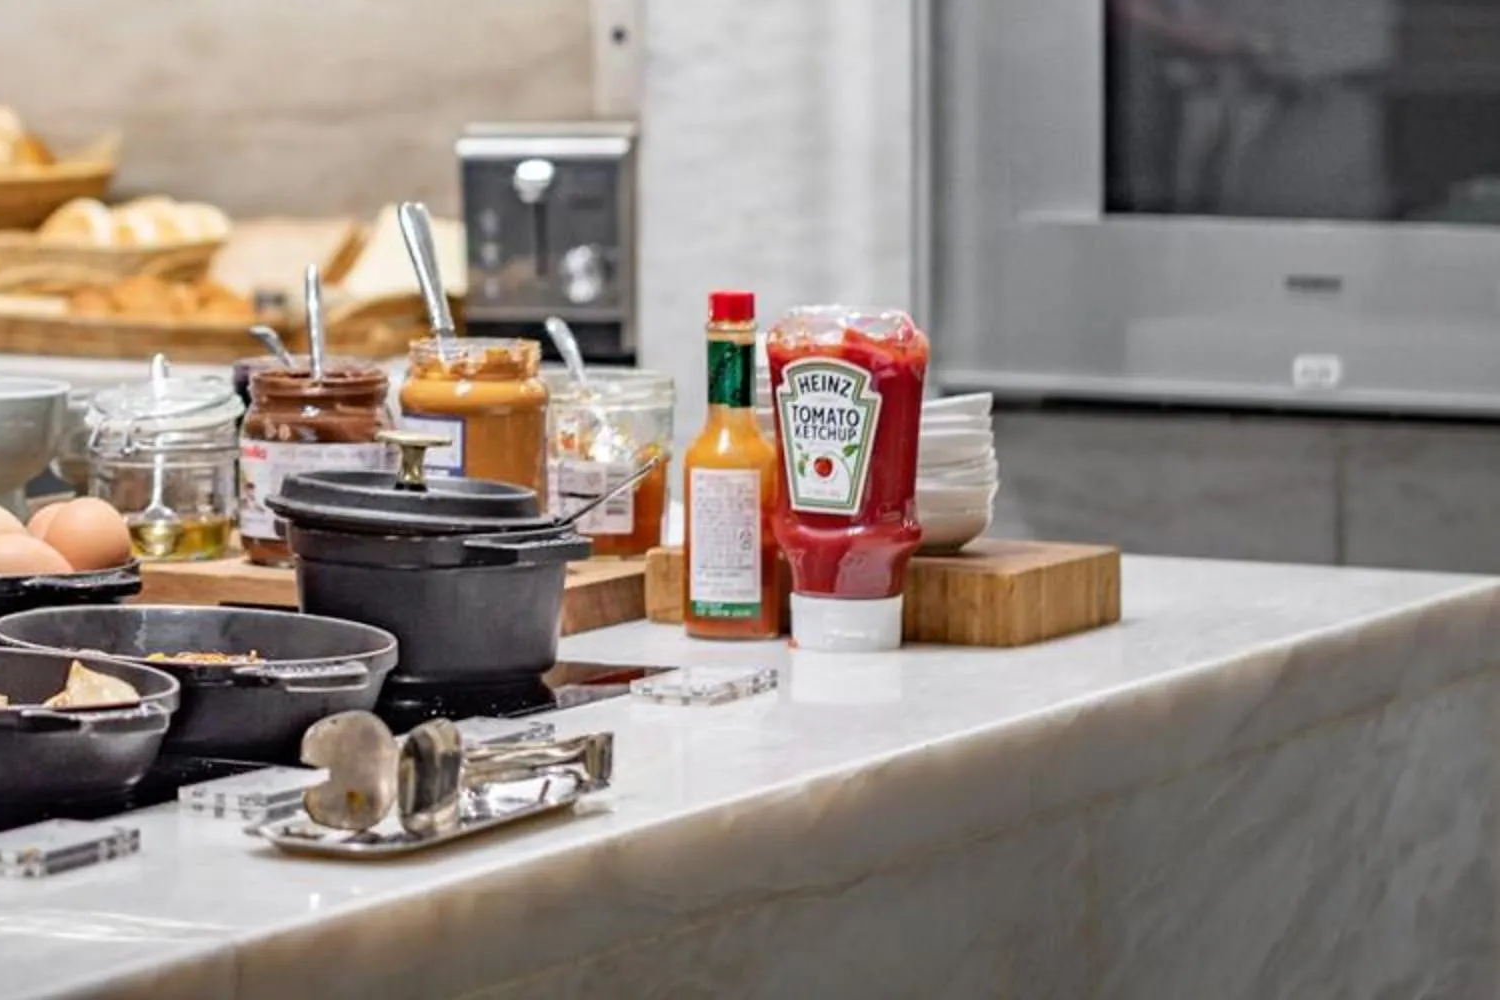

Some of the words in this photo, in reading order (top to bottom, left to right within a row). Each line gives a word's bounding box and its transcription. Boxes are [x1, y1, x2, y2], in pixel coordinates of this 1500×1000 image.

[798, 374, 853, 398] HEINZ
[792, 405, 861, 427] TOMATO
[795, 424, 857, 441] KETCHUP
